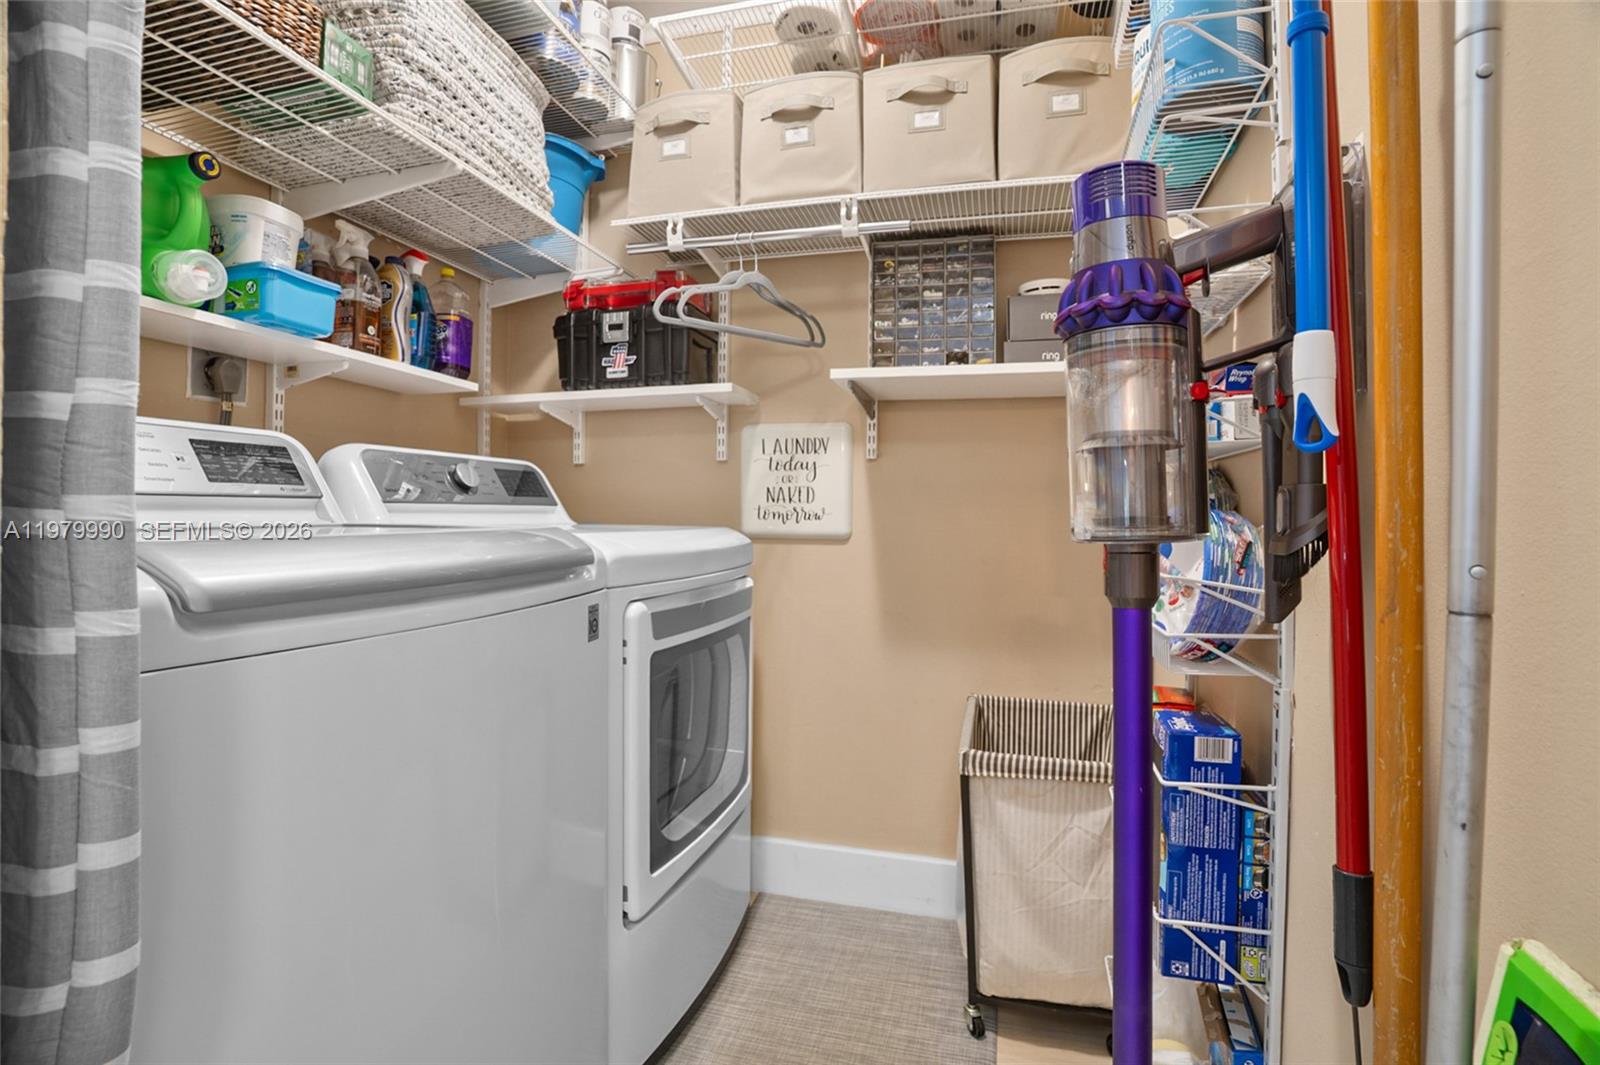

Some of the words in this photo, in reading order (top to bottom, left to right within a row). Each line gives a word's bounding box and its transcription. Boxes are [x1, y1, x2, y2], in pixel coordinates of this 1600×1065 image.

[1126, 224, 1136, 251] dyson
[1040, 311, 1058, 322] ring
[1041, 351, 1060, 362] ring
[1228, 375, 1247, 384] Wrap
[761, 437, 830, 455] LAUNDRY
[768, 455, 817, 482] today
[766, 486, 815, 504] NAKED
[756, 504, 828, 525] tomorrow
